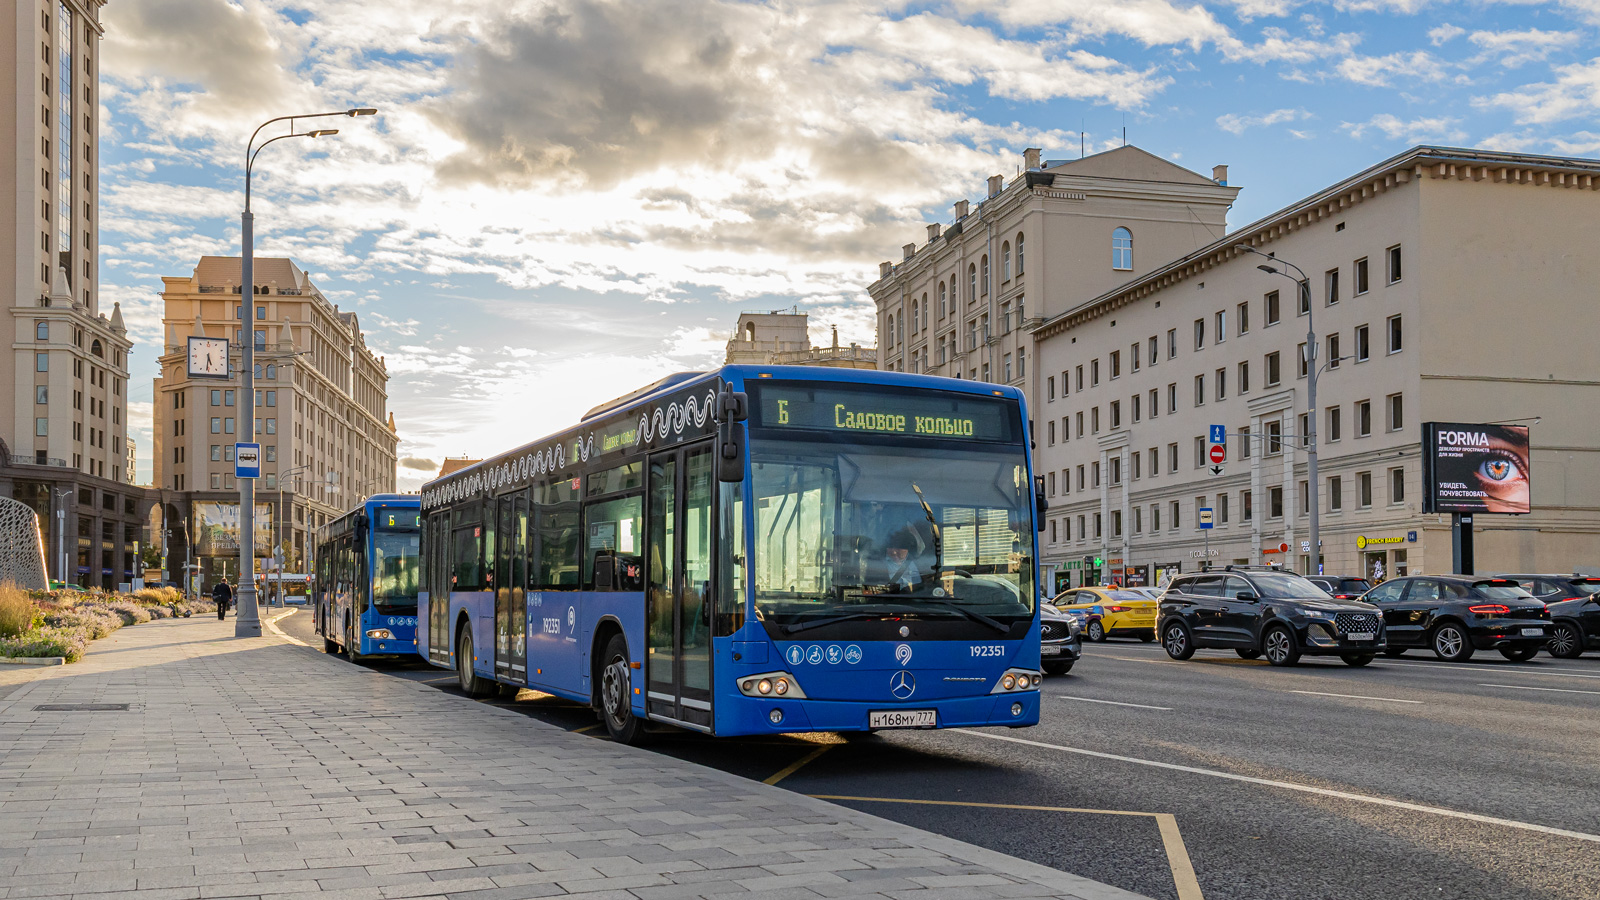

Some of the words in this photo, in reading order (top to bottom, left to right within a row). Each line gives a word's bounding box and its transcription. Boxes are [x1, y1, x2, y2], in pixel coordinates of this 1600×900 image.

[778, 400, 789, 424] Б
[834, 404, 905, 432] Садовое
[915, 415, 974, 436] кольцо
[1438, 430, 1490, 446] FORMA
[389, 515, 395, 526] Б
[543, 617, 561, 634] 192351
[969, 645, 1005, 657] 192351
[917, 712, 933, 721] 777
